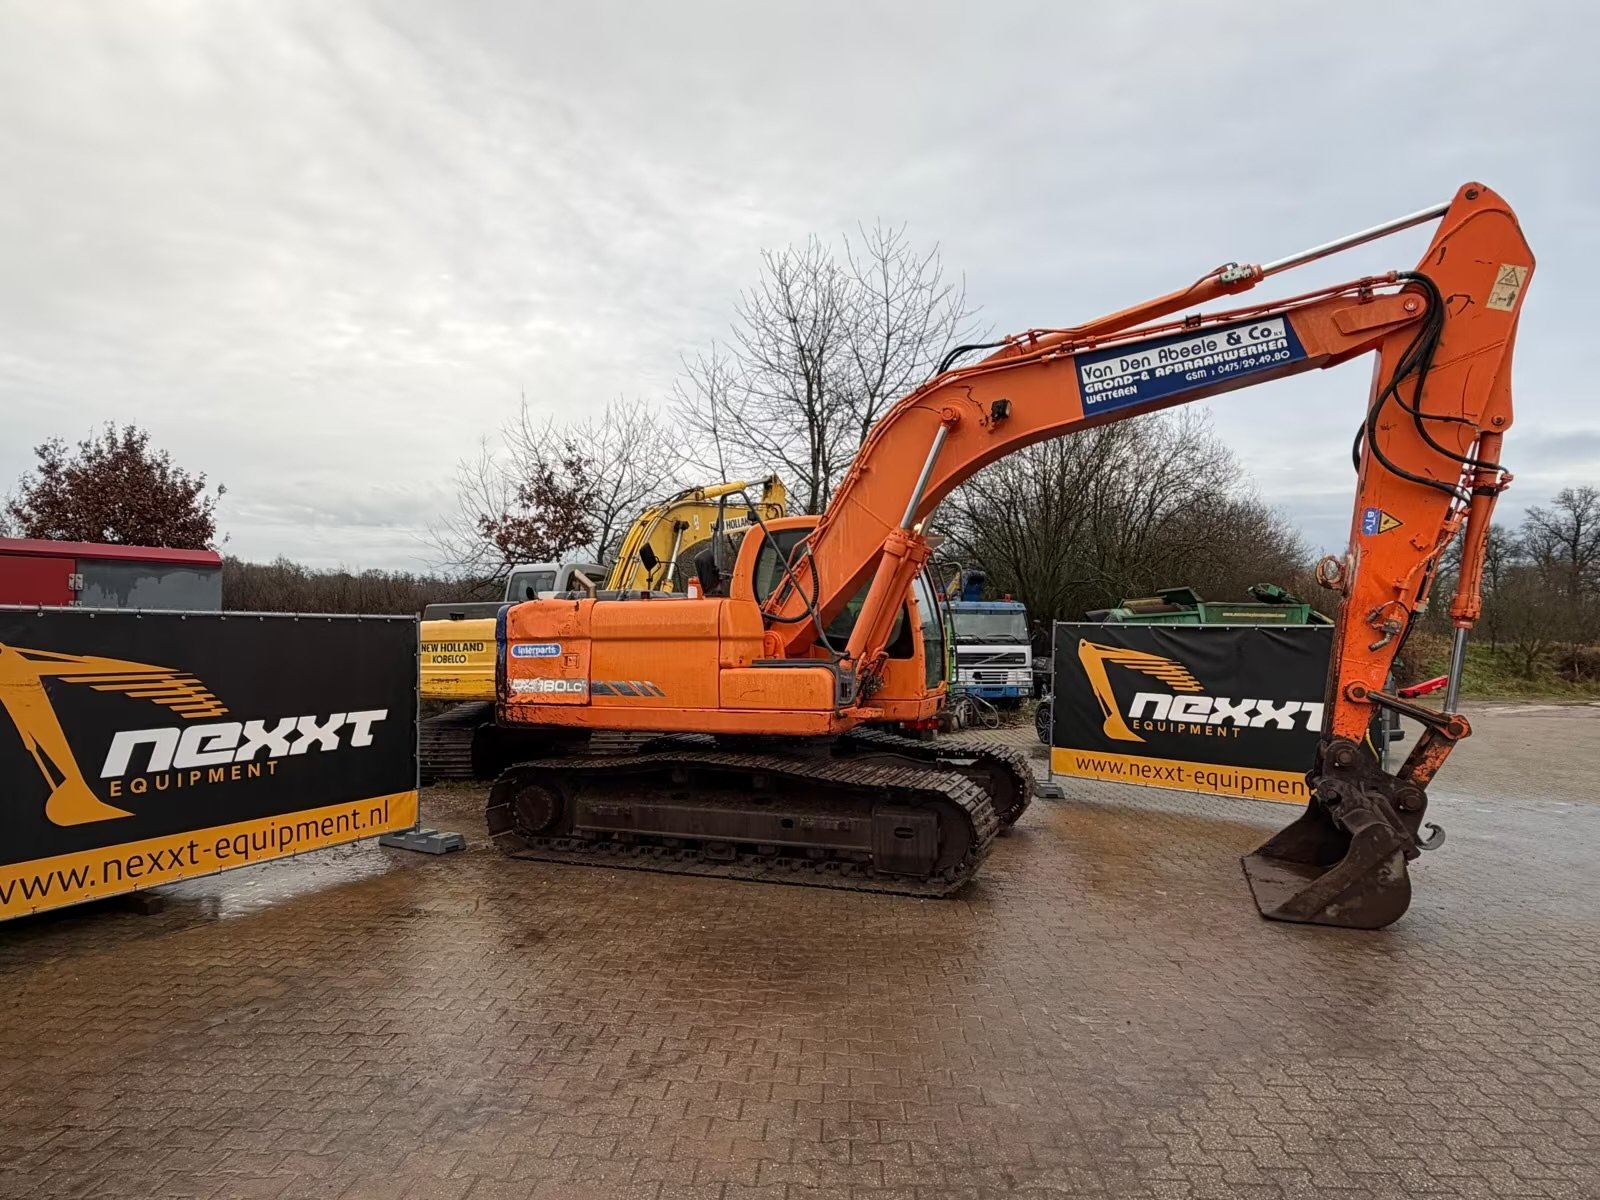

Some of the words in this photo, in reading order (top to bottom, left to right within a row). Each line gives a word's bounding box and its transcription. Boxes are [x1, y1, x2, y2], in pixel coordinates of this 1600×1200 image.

[1083, 365, 1113, 381] Van
[1119, 355, 1151, 373] Den
[1158, 338, 1218, 364] Abeele
[1226, 331, 1243, 347] &
[1155, 338, 1288, 378] AFBRAAKWERKEN
[1185, 369, 1207, 382] GSM
[1218, 350, 1290, 375] 0475/29.49.80
[1086, 385, 1138, 405] WETTEREN
[421, 643, 439, 653] NEW
[440, 642, 484, 653] HOLLAND
[432, 655, 467, 664] KOBELCO
[1133, 720, 1241, 738] EQUIPMENT
[110, 760, 279, 797] EQUIPMENT
[1075, 756, 1310, 797] www.nexxt-equipmen
